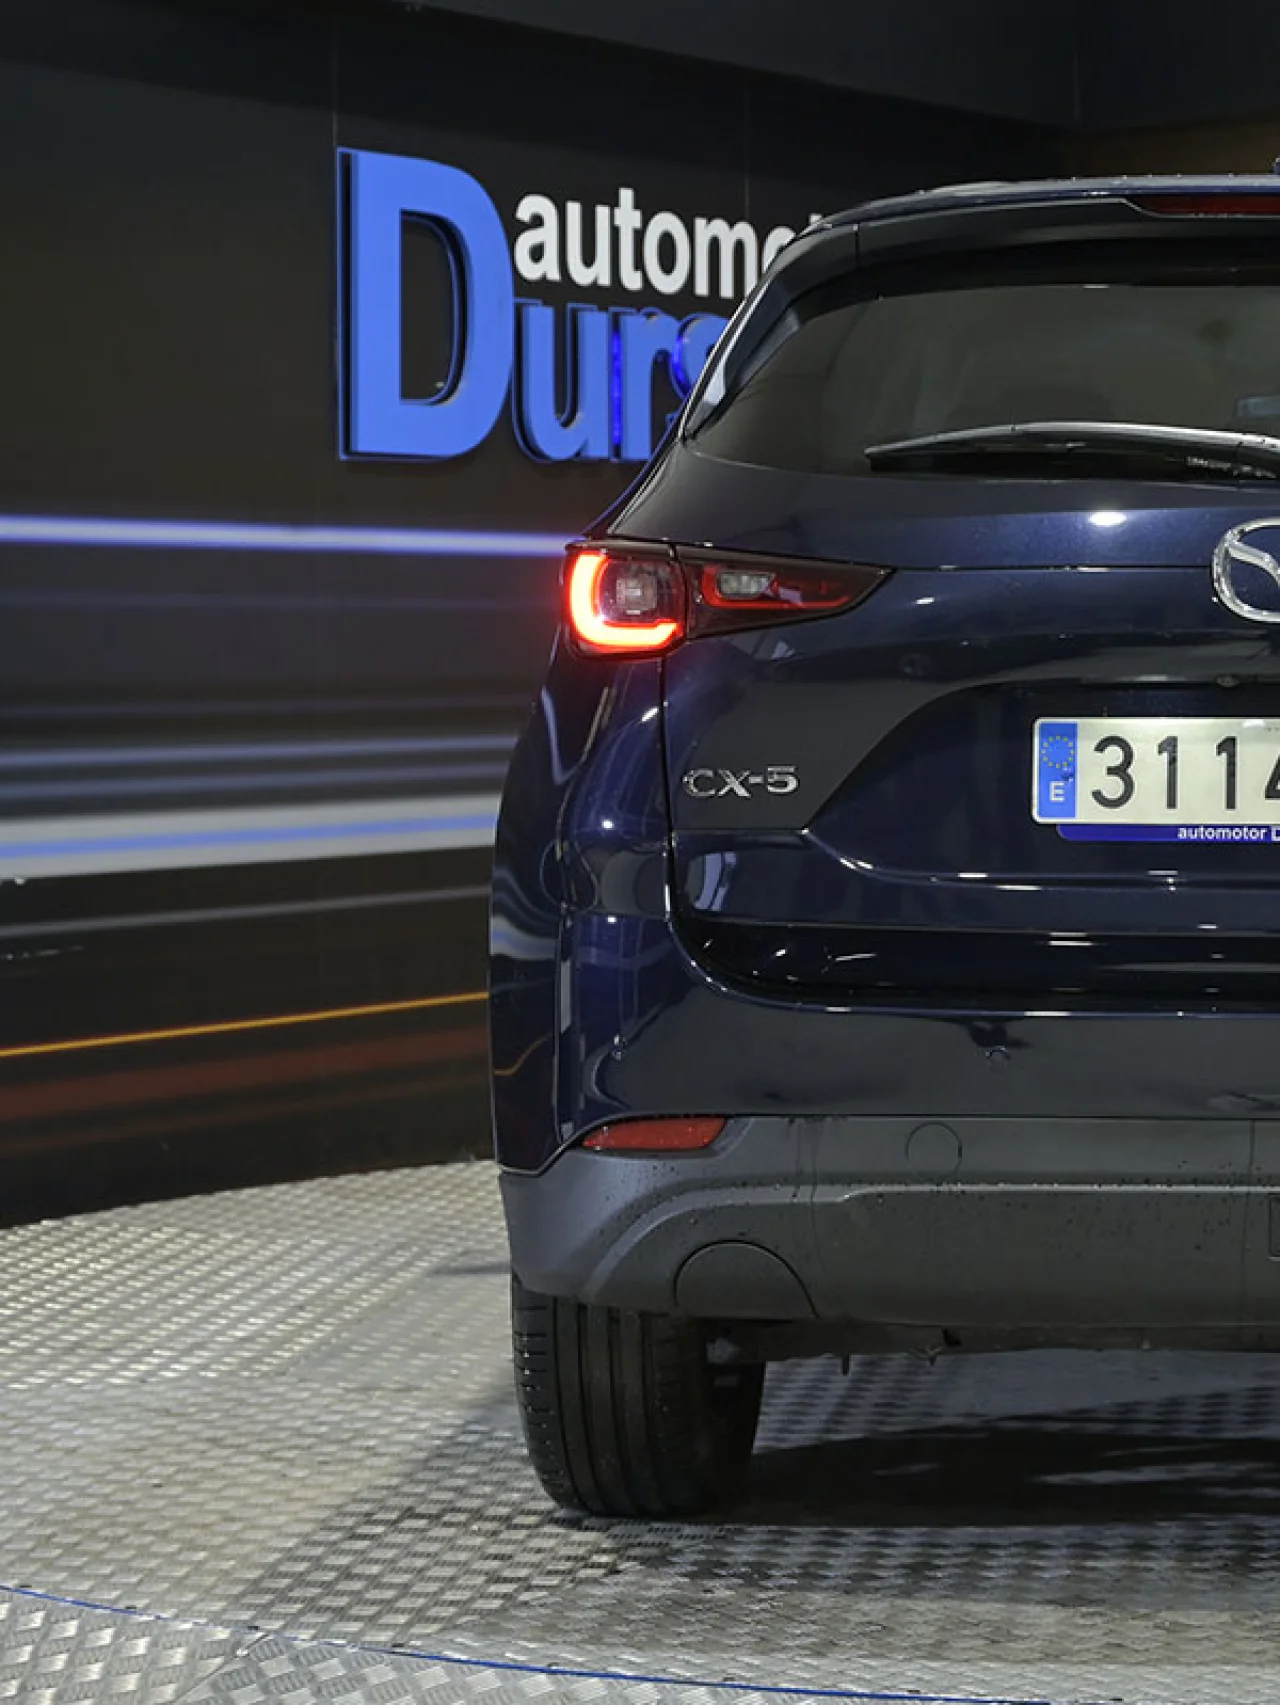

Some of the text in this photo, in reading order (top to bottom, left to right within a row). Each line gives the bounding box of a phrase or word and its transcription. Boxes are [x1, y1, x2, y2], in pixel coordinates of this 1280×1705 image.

[514, 187, 821, 299] autom
[683, 766, 799, 797] CX-5
[1050, 781, 1065, 802] E
[1177, 826, 1267, 840] automotor
